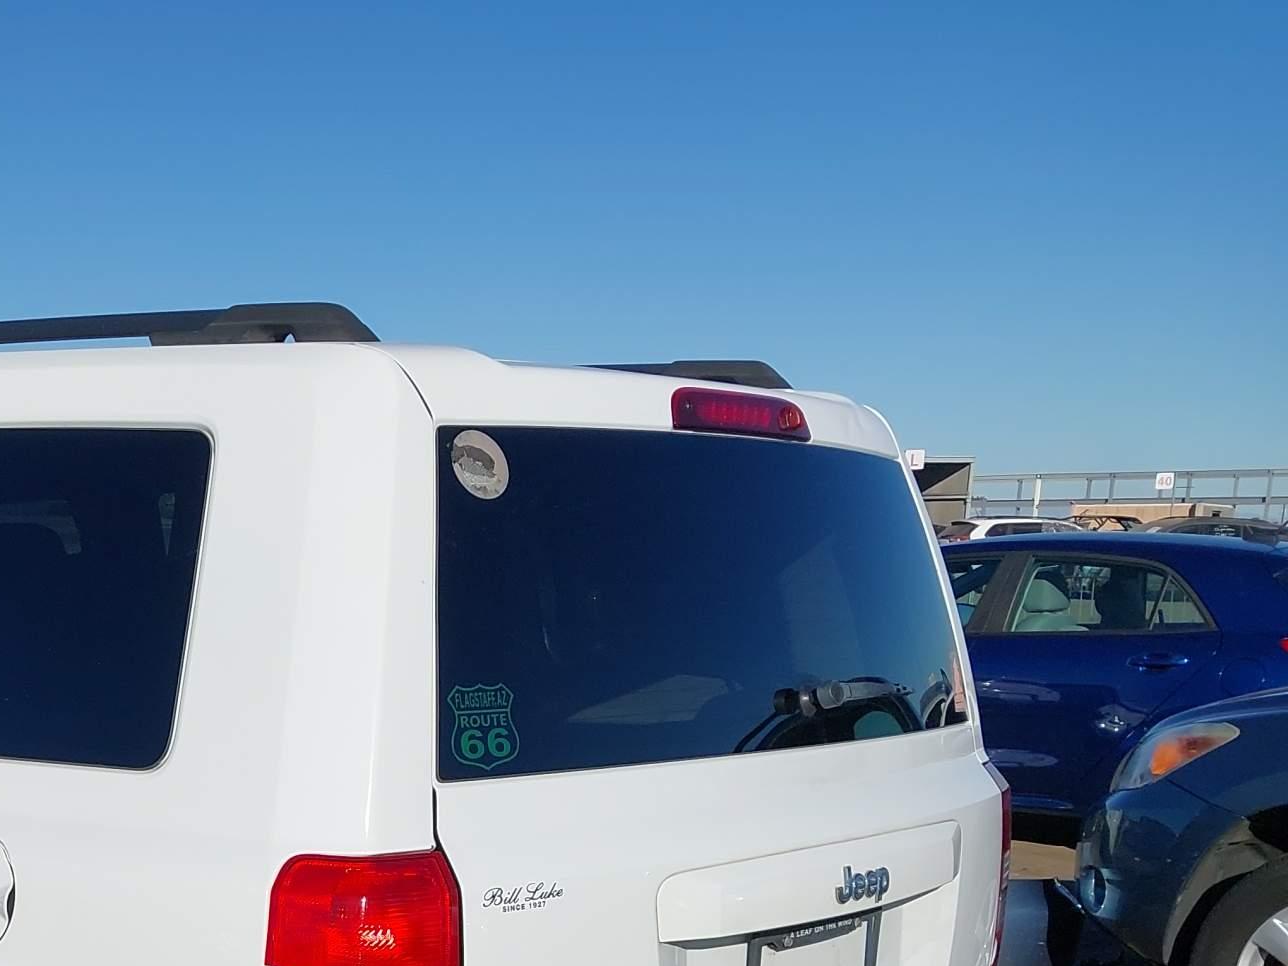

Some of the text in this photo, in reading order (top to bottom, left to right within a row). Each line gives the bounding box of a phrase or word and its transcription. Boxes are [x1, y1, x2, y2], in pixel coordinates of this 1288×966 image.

[1158, 476, 1172, 486] 40
[459, 713, 508, 729] ROUTE
[461, 727, 511, 759] 66
[835, 865, 890, 905] Jeep
[482, 881, 564, 908] Bill Luke
[502, 900, 546, 913] SINCE 1927
[796, 927, 813, 938] LEAF
[814, 925, 824, 933] ON
